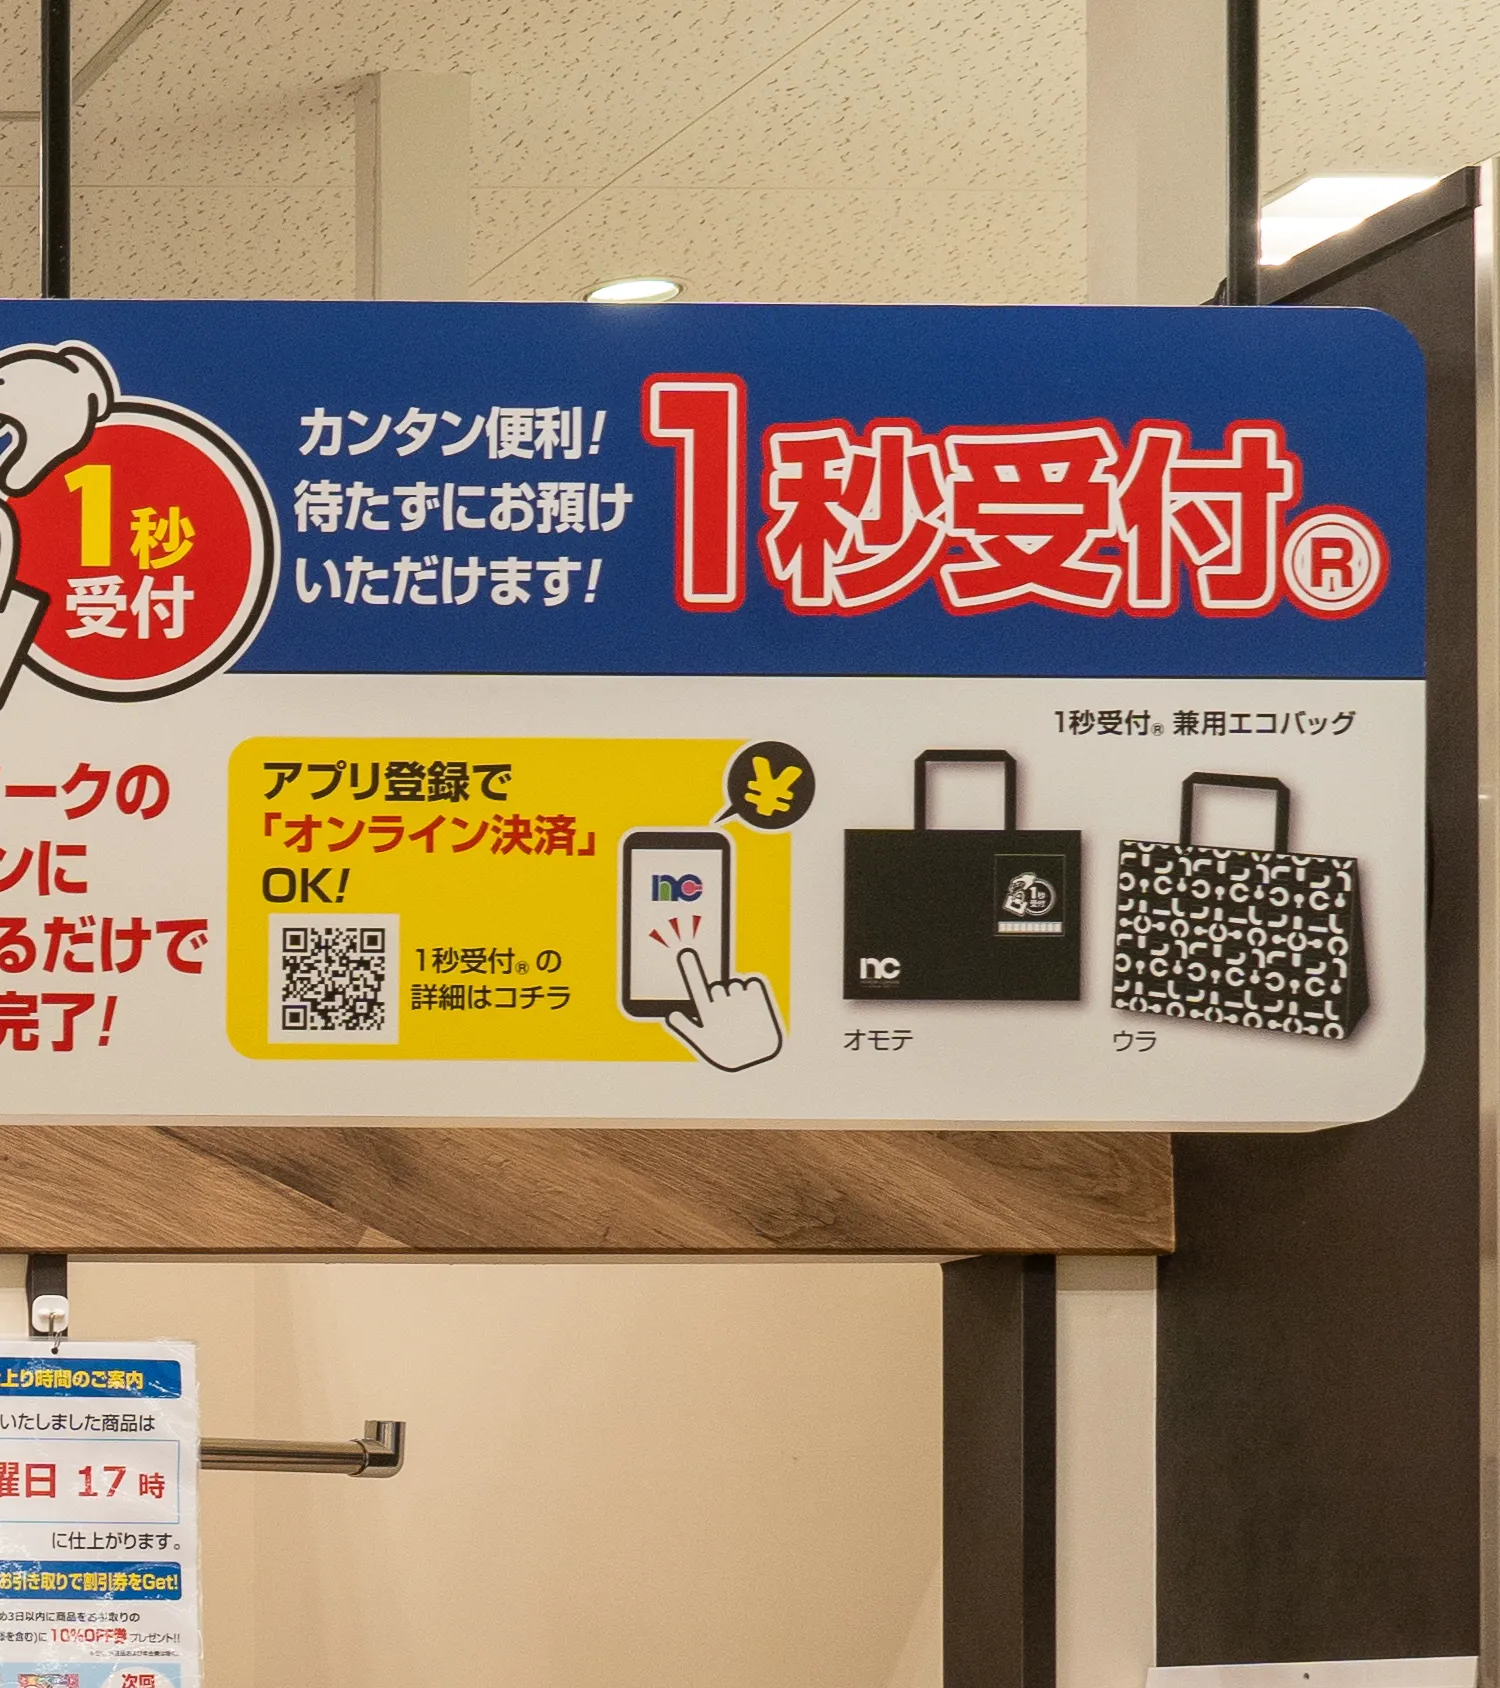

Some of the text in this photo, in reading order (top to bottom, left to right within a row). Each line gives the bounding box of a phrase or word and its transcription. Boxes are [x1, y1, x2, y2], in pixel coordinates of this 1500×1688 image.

[299, 407, 606, 459] カンタン便利!
[65, 464, 196, 570] 1秒
[294, 480, 633, 533] 待たずにお預け
[296, 556, 601, 607] いただけます!
[65, 577, 195, 640] 受付
[1173, 709, 1357, 737] 兼用エコバッグ
[262, 760, 512, 803] アプリ登録で
[262, 813, 597, 857] 「オンライン決済」
[262, 866, 349, 904] OK!
[411, 985, 570, 1012] 詳細はコチラ
[843, 1029, 913, 1054] オモテ
[1113, 1030, 1157, 1052] ウラ
[78, 1465, 126, 1497] 17
[139, 1472, 165, 1498] 時
[52, 1532, 180, 1550] に仕上がります。
